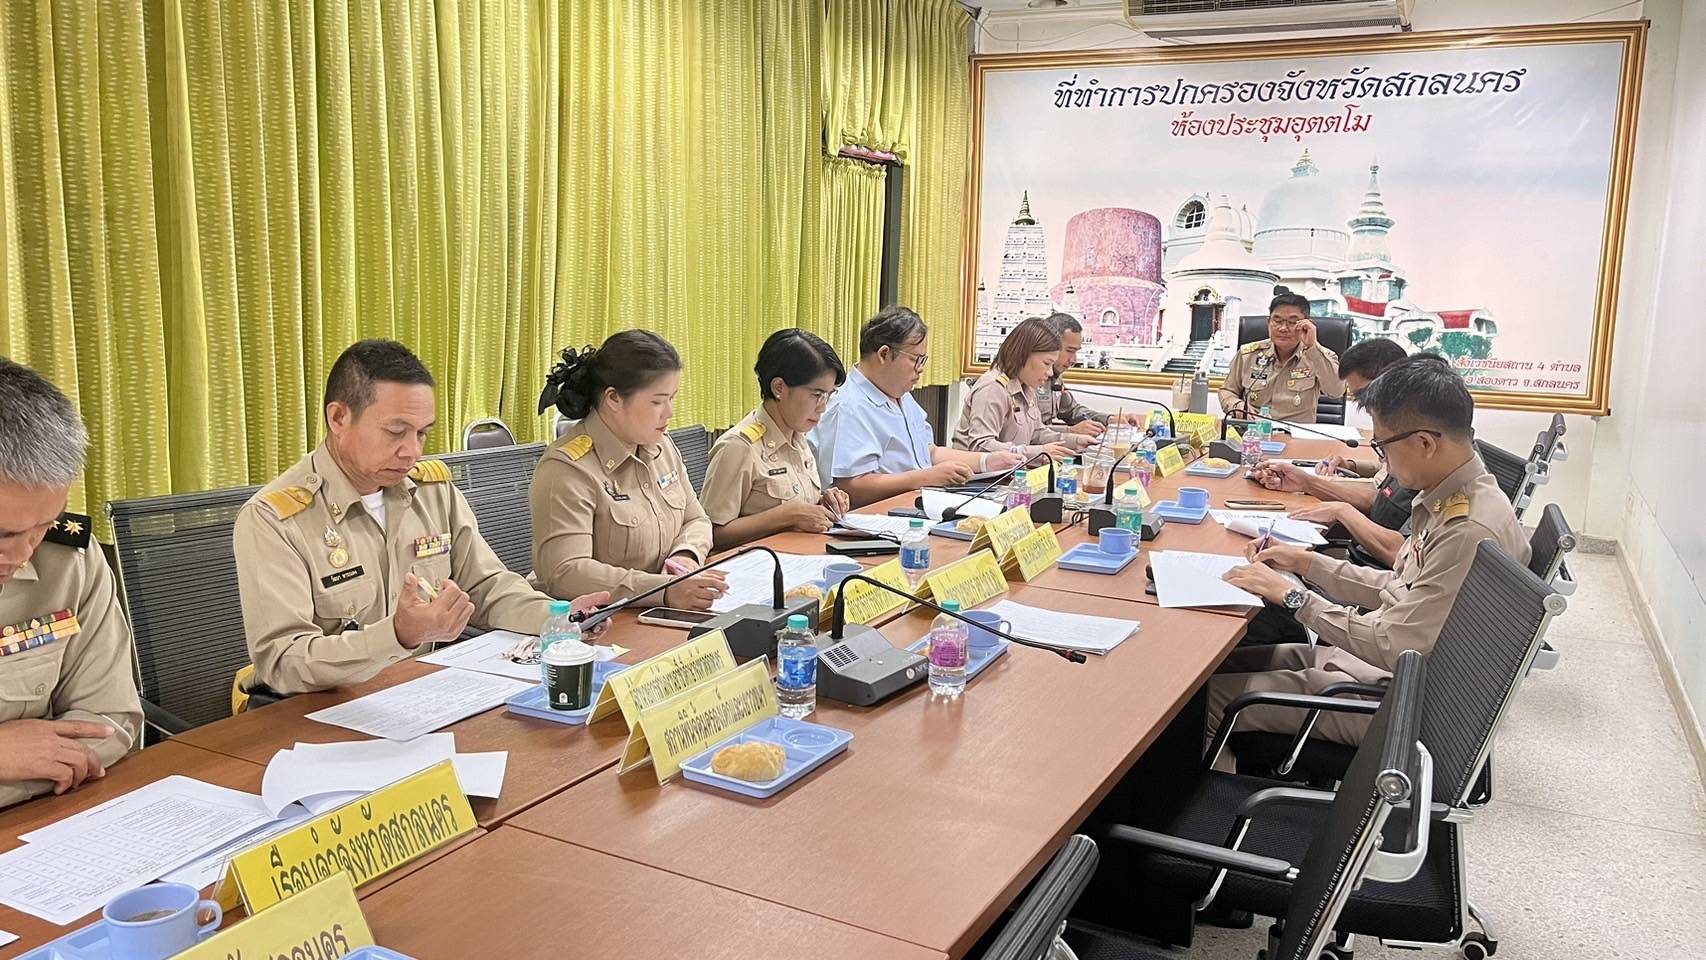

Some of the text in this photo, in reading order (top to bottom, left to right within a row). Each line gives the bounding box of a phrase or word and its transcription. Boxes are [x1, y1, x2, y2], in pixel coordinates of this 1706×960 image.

[1053, 67, 1527, 109] ที่ทำการปกครองจังหวัดสกลนคร
[1171, 104, 1373, 143] ห้องประชุมอุตตโม
[1536, 361, 1545, 371] 4
[1549, 359, 1582, 373] ตำบล
[1523, 379, 1581, 390] จ.สกลนคร
